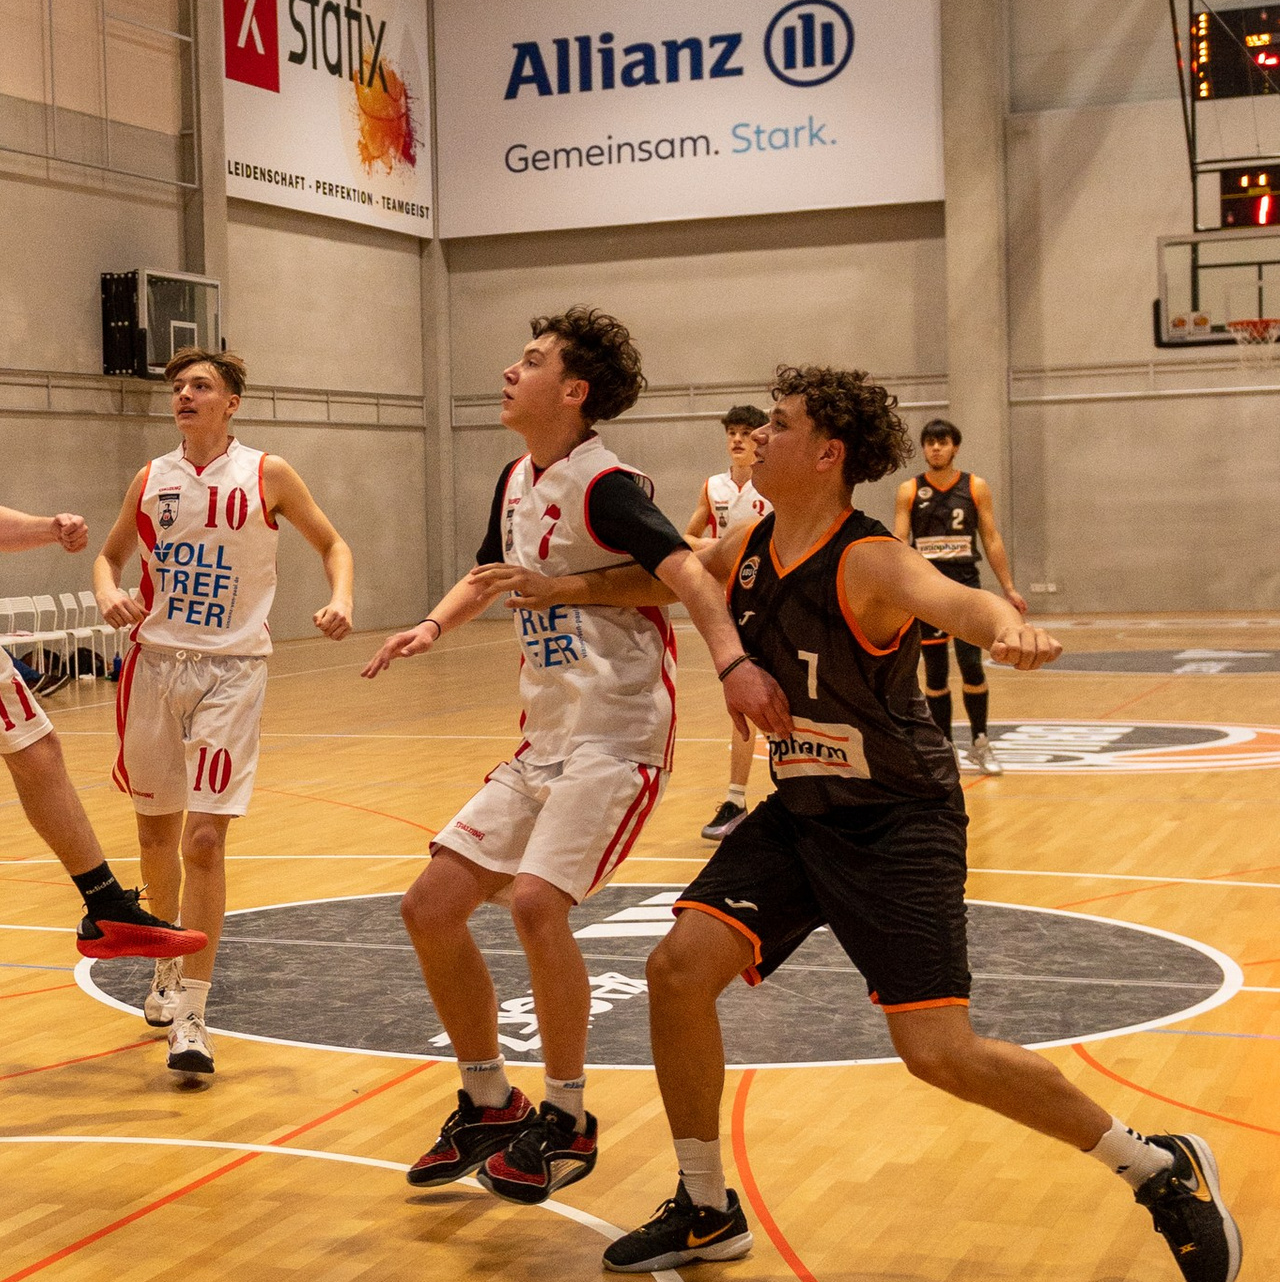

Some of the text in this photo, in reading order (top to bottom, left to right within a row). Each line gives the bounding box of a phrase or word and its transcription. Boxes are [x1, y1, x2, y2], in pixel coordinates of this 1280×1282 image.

[503, 30, 744, 99] Allianz
[503, 115, 838, 174] Gemeinsam. Stark.
[228, 159, 430, 220] LEIDENSCHAFT PERFEKTION TEAMGEIST
[205, 486, 248, 530] 10
[952, 508, 964, 529] 2
[538, 503, 562, 560] 7
[153, 540, 232, 571] VOLL
[156, 568, 232, 598] TREF
[167, 597, 225, 628] FER
[513, 604, 568, 636] REF
[193, 747, 232, 794] 10
[86, 877, 114, 895] adidas
